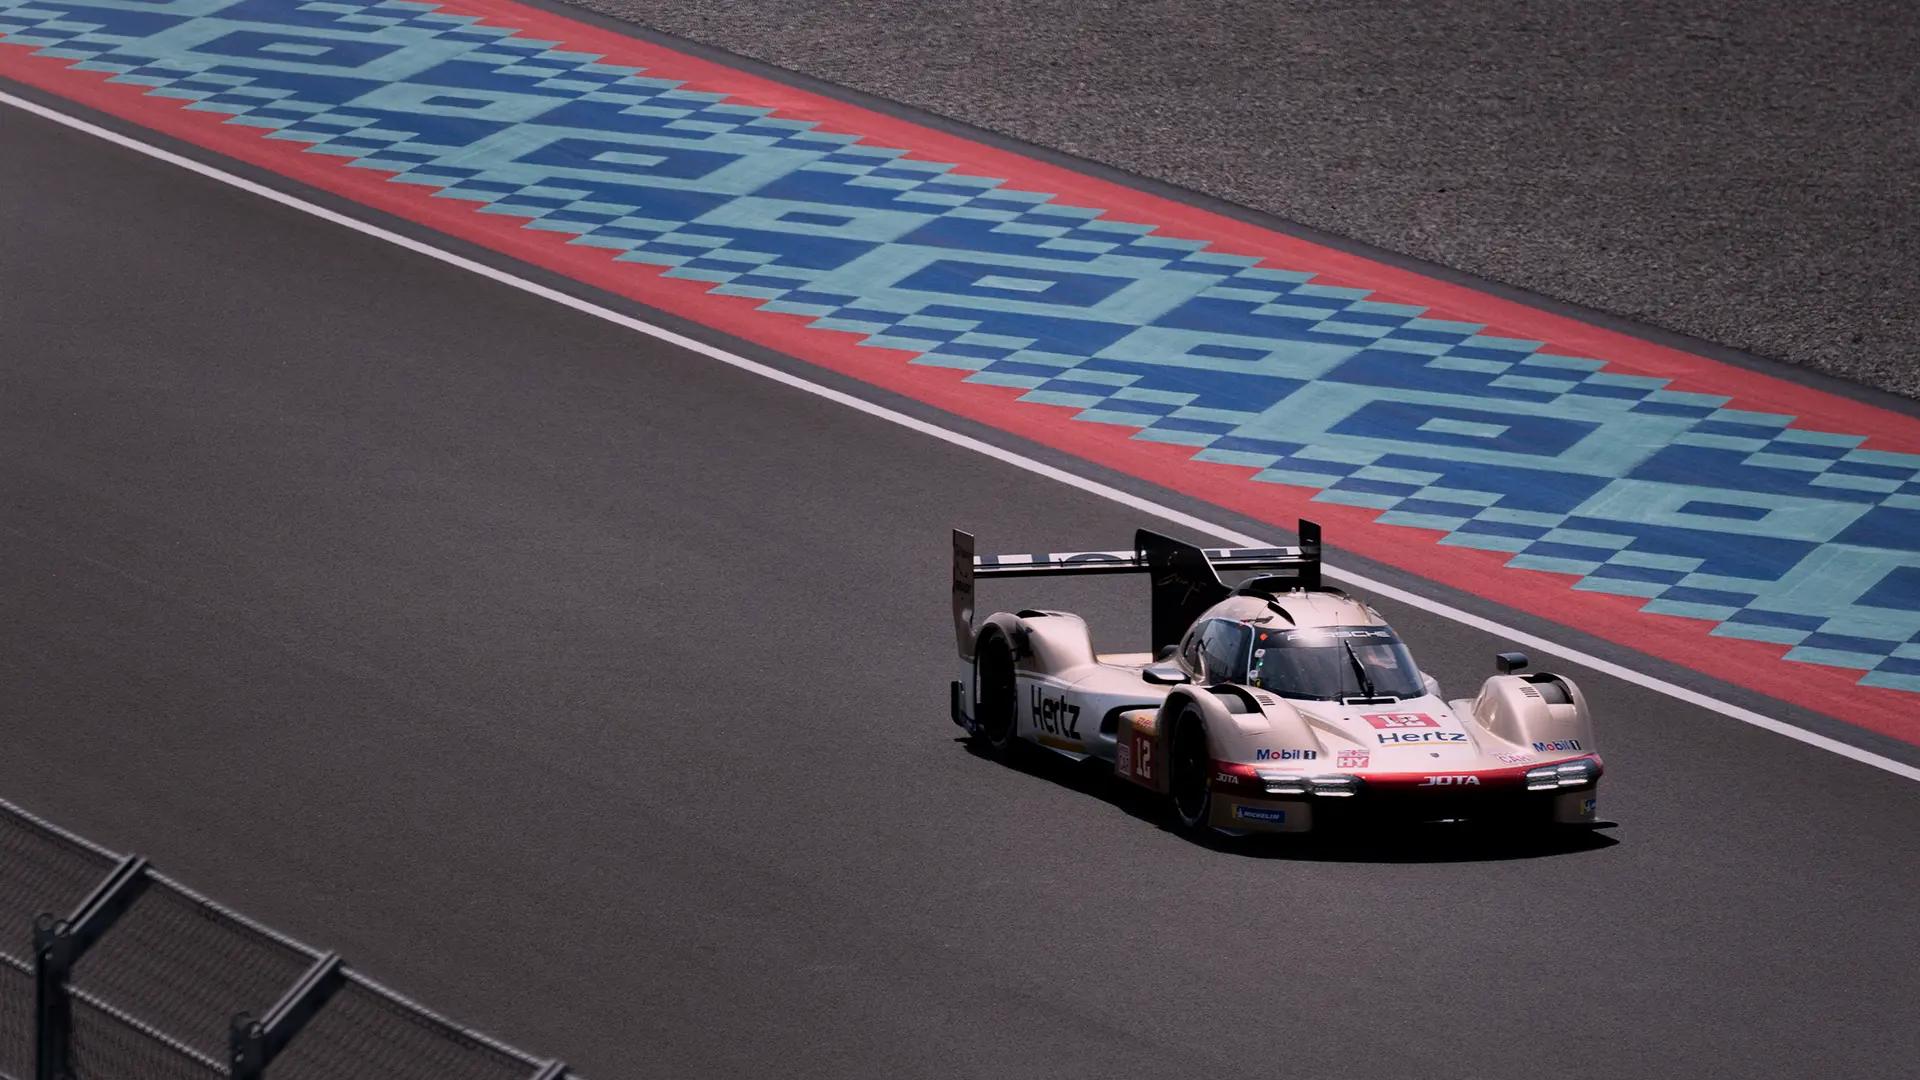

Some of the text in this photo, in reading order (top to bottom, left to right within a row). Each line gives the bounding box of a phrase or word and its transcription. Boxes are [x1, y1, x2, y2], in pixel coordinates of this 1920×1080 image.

[1031, 684, 1082, 740] Hertz
[1377, 714, 1429, 728] 12
[1377, 731, 1467, 743] Hertz
[1532, 740, 1570, 752] Mobil
[1135, 736, 1151, 780] 12
[1256, 749, 1300, 760] Mobil
[1418, 775, 1480, 786] JOTA
